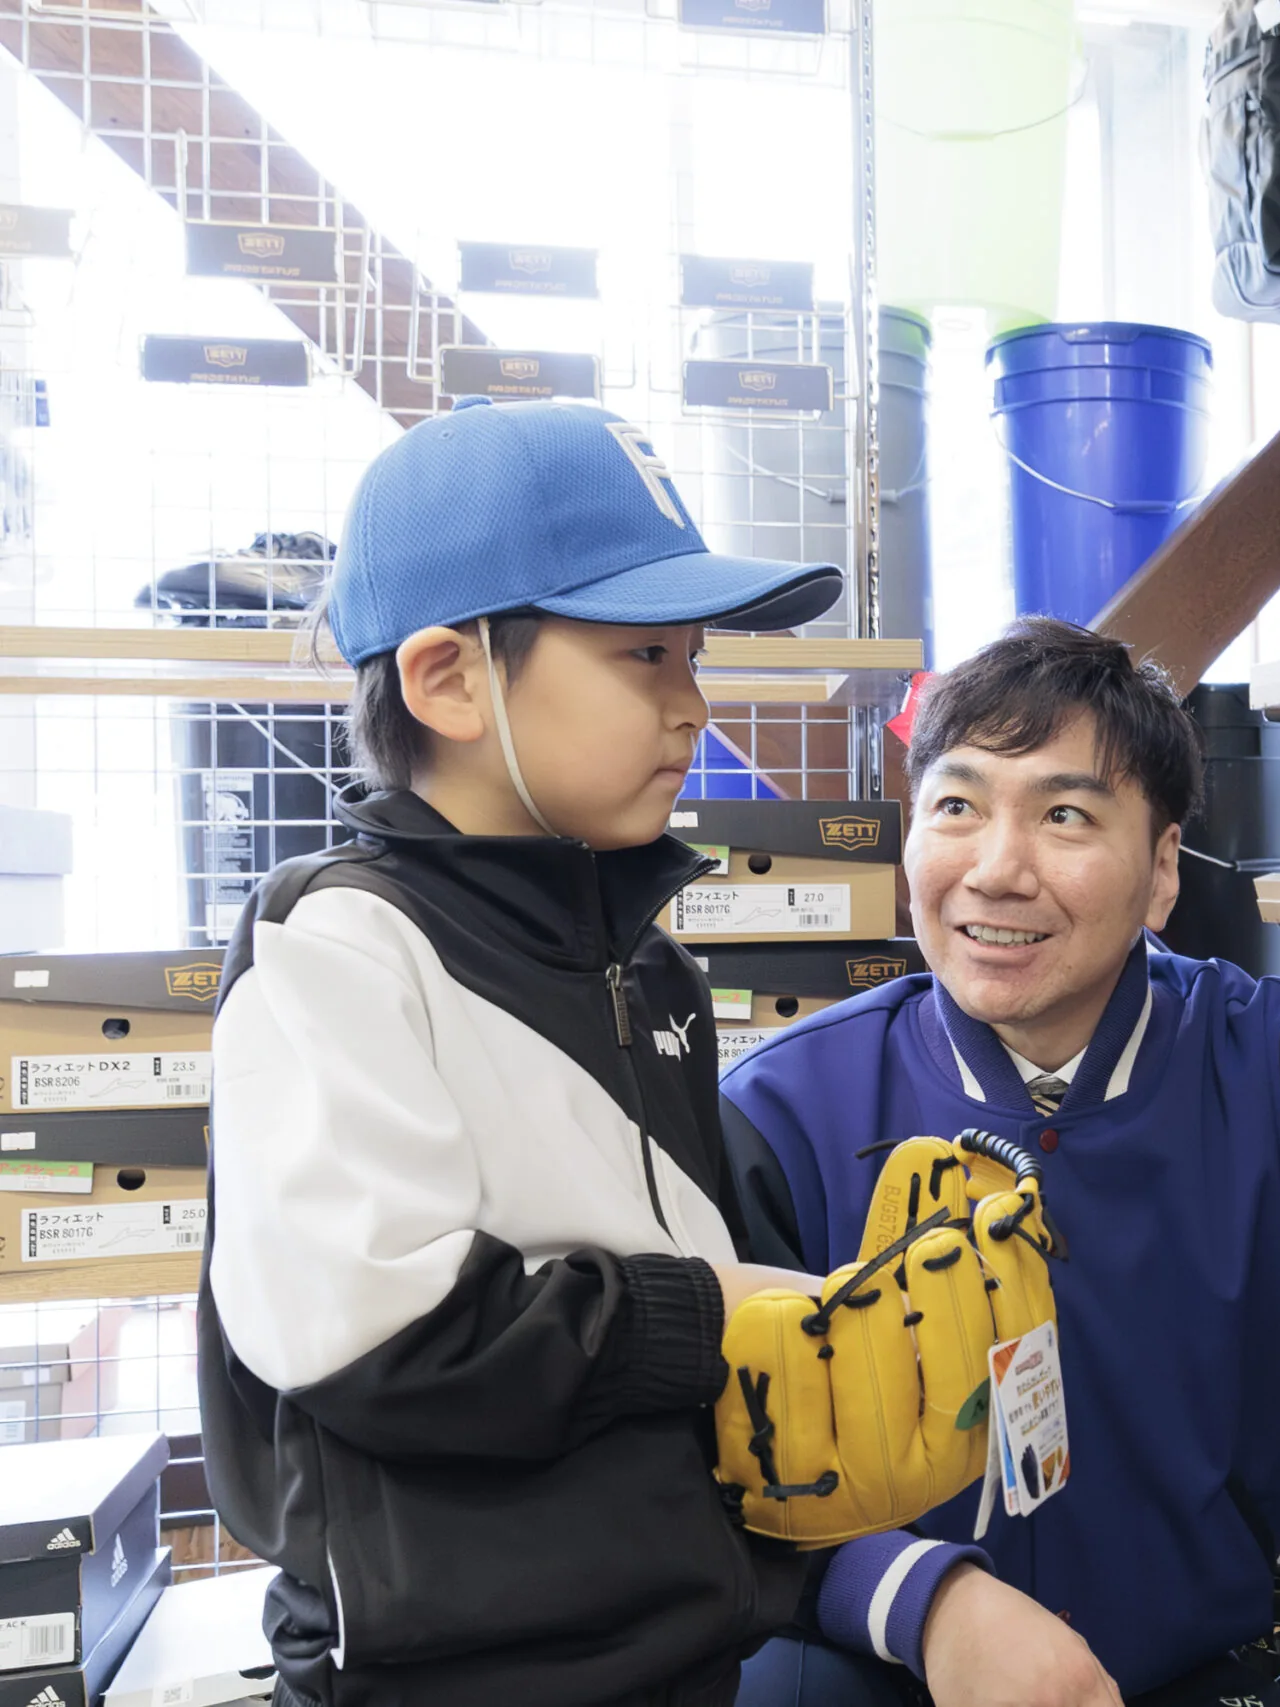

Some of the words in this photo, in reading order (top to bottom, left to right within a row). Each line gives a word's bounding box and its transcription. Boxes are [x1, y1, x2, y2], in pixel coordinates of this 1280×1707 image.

[826, 823, 876, 837] ZETT
[685, 891, 739, 901] ラフィエット
[804, 893, 824, 902] 27.0
[853, 963, 902, 976] ZETT
[173, 971, 222, 987] ZET
[717, 1048, 730, 1059] SR
[172, 1061, 196, 1072] 23.5
[39, 1212, 104, 1225] ラフィエット
[182, 1208, 206, 1220] 25.0
[46, 1540, 82, 1551] adidas
